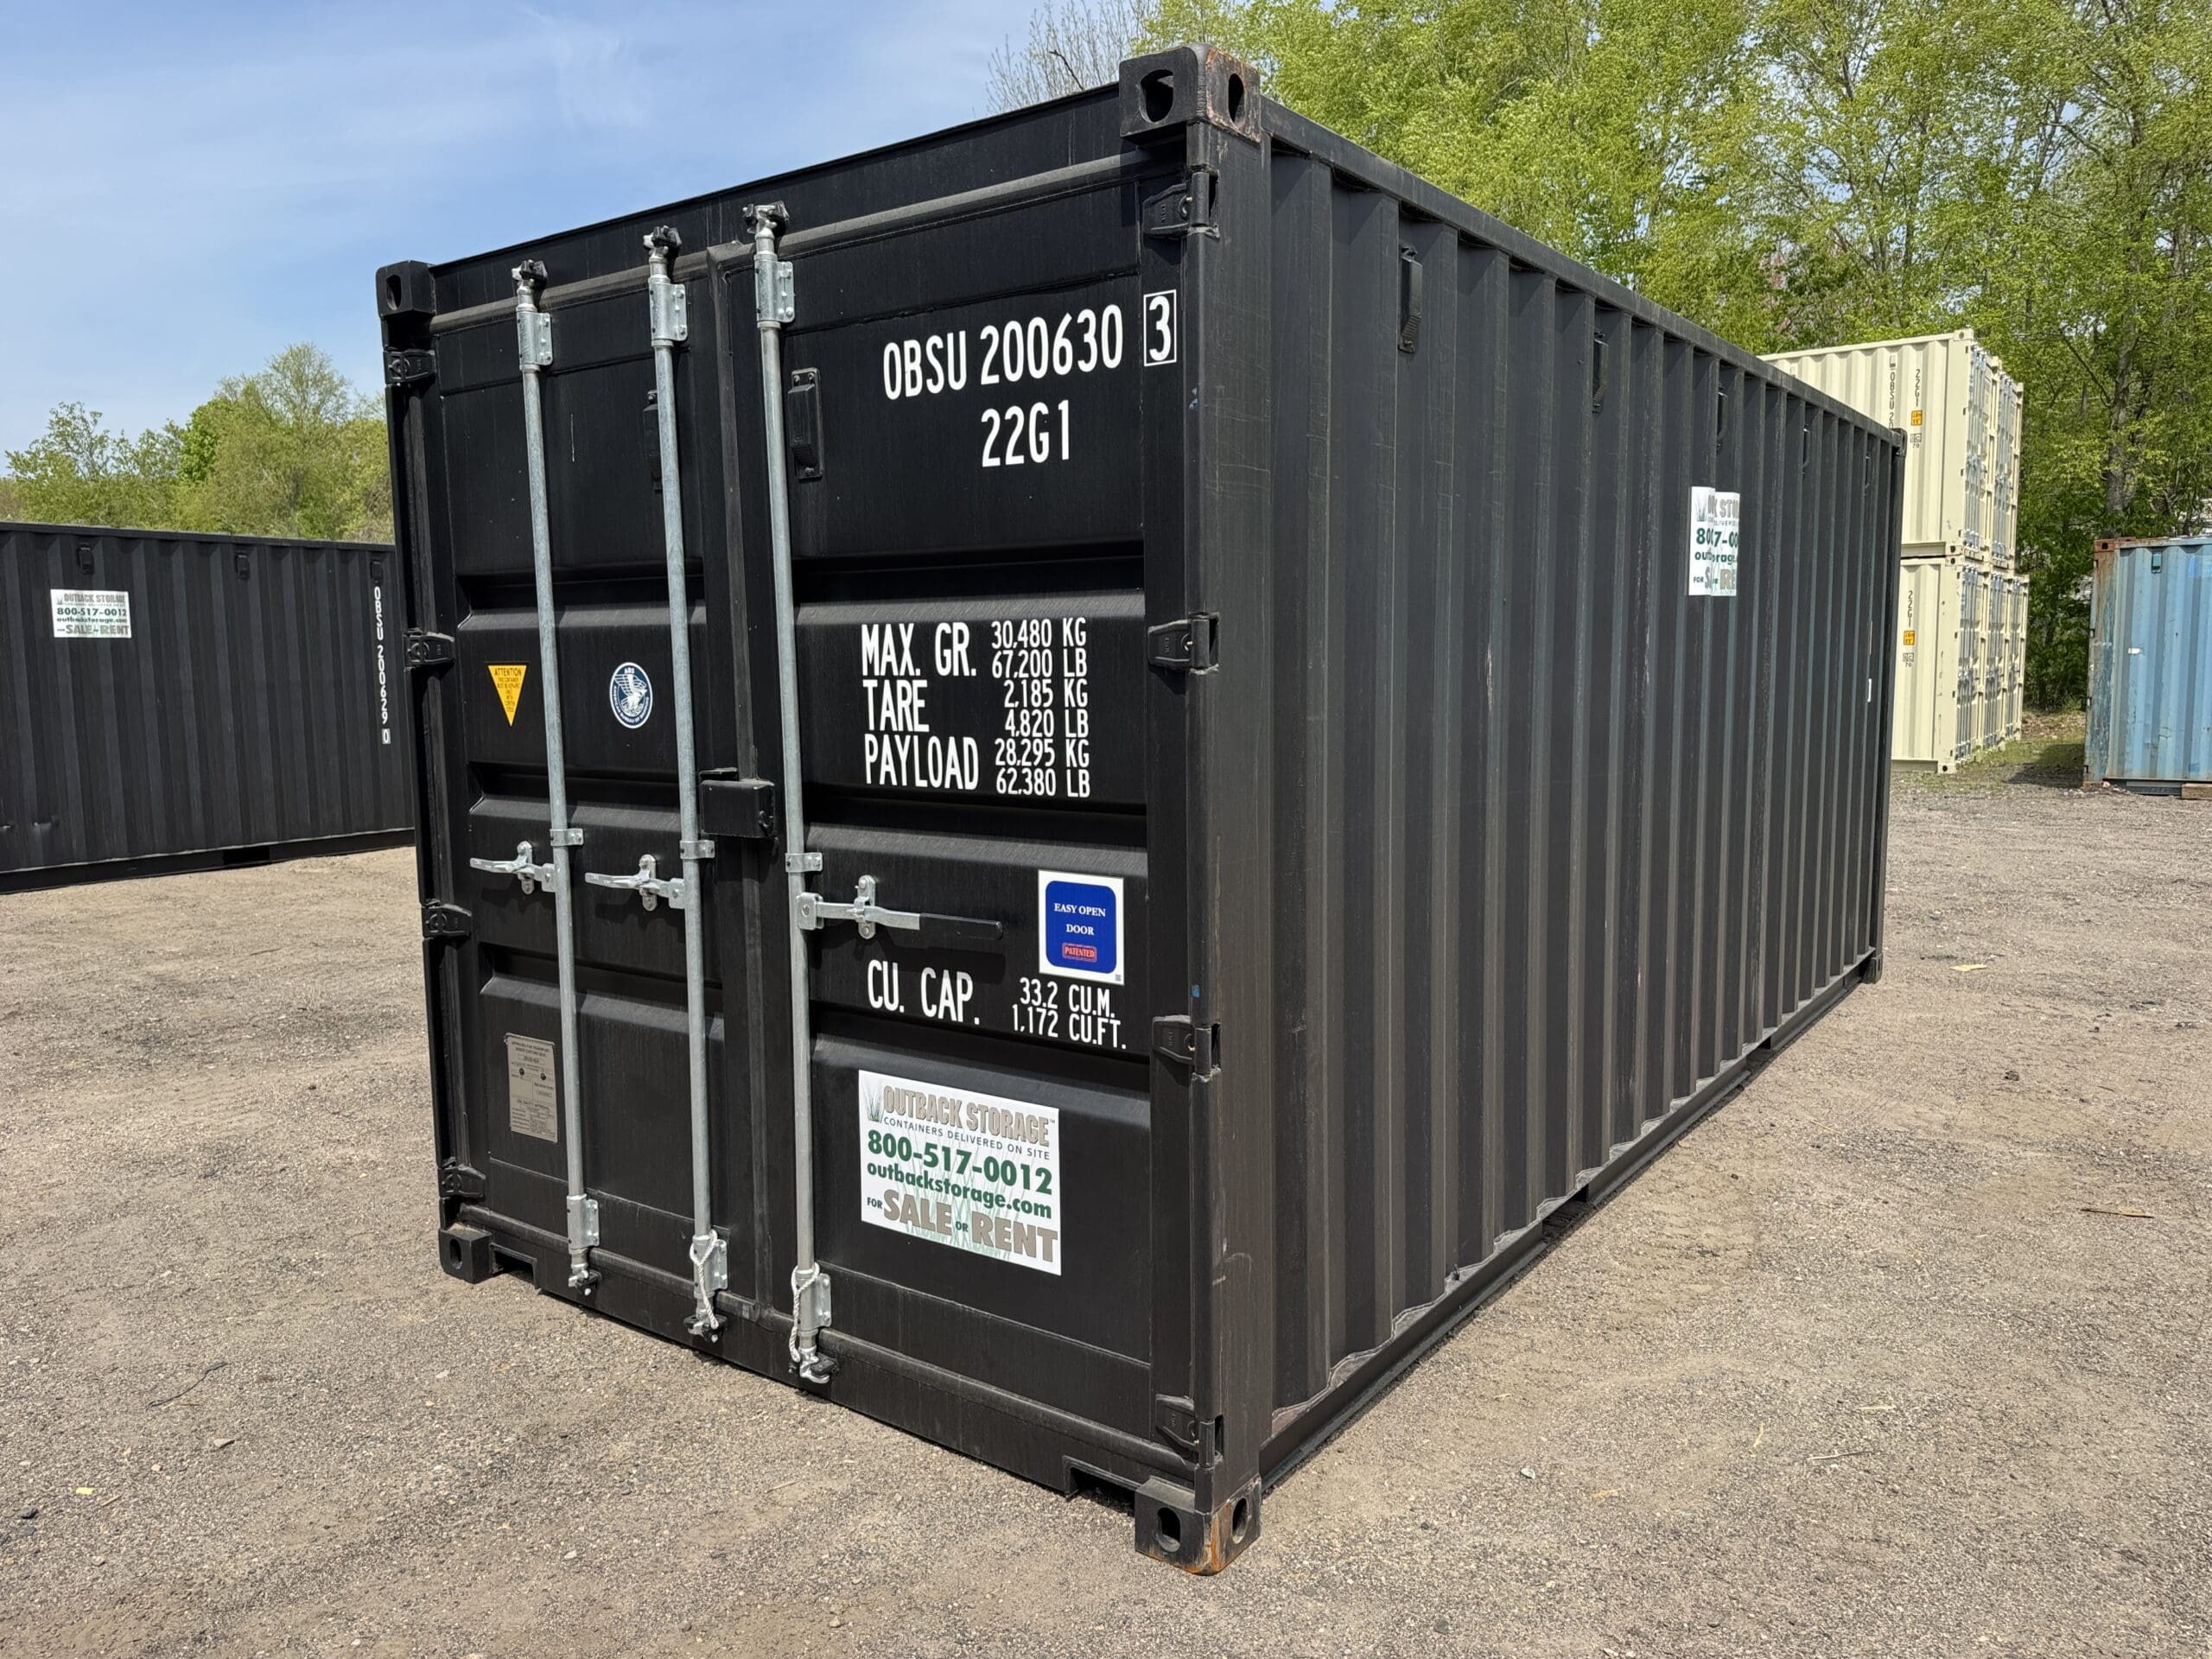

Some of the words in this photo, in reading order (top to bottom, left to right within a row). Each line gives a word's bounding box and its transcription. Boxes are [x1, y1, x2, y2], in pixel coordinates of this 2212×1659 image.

[883, 330, 967, 400] OBSU
[980, 304, 1123, 385] 200630
[1148, 295, 1172, 362] 3
[981, 399, 1070, 467] 22G1
[57, 607, 127, 617] 800-517-0012
[66, 625, 92, 634] SALE
[100, 625, 129, 635] RENT
[374, 586, 384, 640] OBSU
[495, 667, 522, 677] ATTENTION
[861, 623, 921, 677] MAX.
[935, 622, 976, 677] GR.
[992, 619, 1052, 649] 30,480
[1063, 617, 1086, 647] KG
[993, 649, 1053, 678] 67,200
[1064, 648, 1087, 677] LB
[377, 645, 388, 725] 200629
[863, 679, 930, 732] TARE
[1004, 678, 1053, 708] 2,185
[1064, 678, 1088, 708] KG
[1005, 709, 1054, 737] 4,820
[1065, 709, 1089, 738] LB
[864, 734, 979, 790] PAYLOAD
[995, 738, 1055, 766] 28,295
[1065, 739, 1090, 767] KG
[996, 767, 1056, 796] 62,380
[1066, 768, 1090, 798] LB
[1054, 903, 1077, 913] EASY
[1078, 906, 1106, 917] OPEN
[1065, 924, 1095, 936] DOOR
[1065, 946, 1096, 958] PATENTED
[868, 959, 905, 1013] CU.
[920, 967, 980, 1025] CAP.
[1020, 976, 1058, 1009] 33.2
[1068, 984, 1116, 1019] CU.M.
[1012, 1004, 1058, 1038] 1,172
[883, 1085, 963, 1129] OUTBACK
[966, 1103, 1050, 1147] STORAGE
[884, 1116, 944, 1137] CONTAINERS
[948, 1129, 1003, 1150] DELIVERED
[1007, 1143, 1022, 1154] ON
[1027, 1148, 1050, 1160] SITE
[868, 1129, 1052, 1195] 800-517-0012
[868, 1162, 1052, 1219] outbackstorage.com
[867, 1197, 882, 1210] FOR
[883, 1189, 952, 1236] SALE
[955, 1221, 969, 1232] OR
[971, 1211, 1058, 1262] RENT
